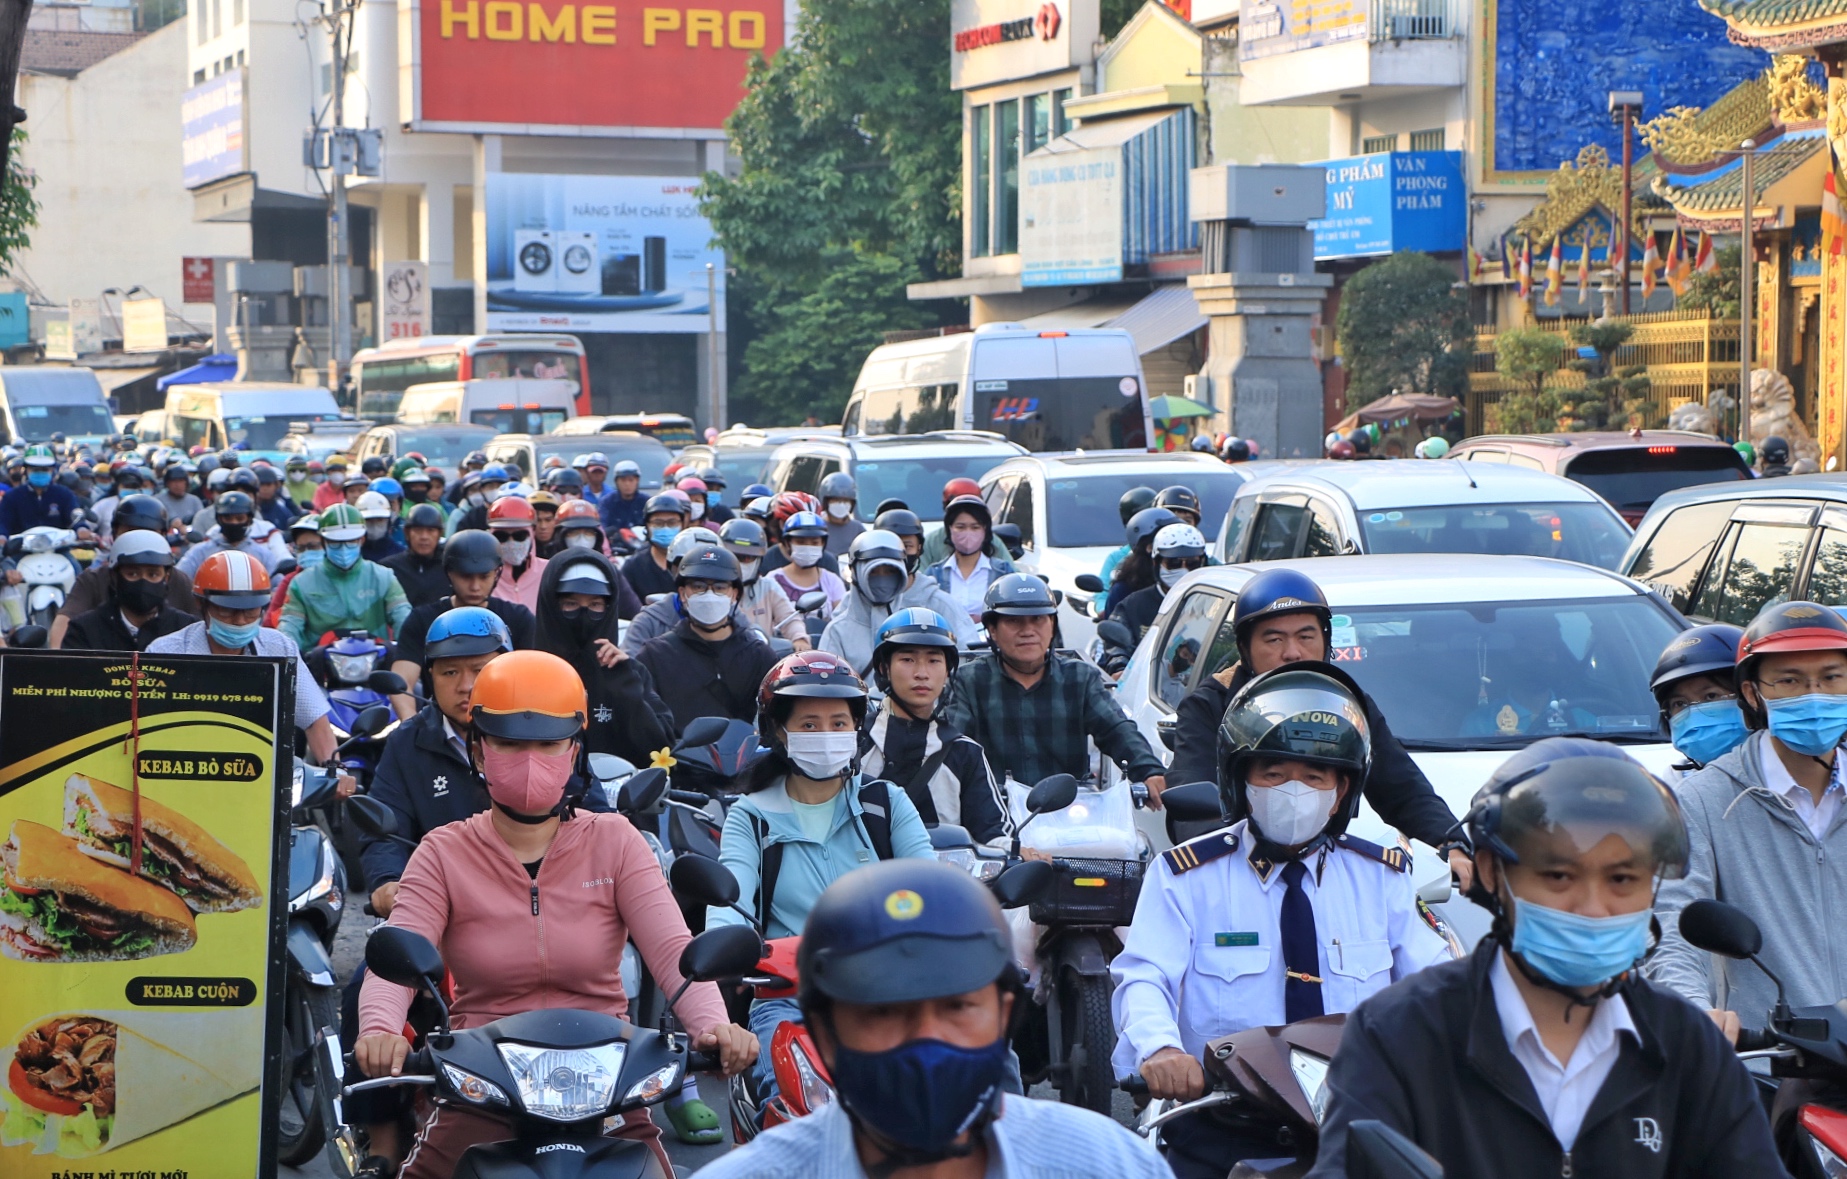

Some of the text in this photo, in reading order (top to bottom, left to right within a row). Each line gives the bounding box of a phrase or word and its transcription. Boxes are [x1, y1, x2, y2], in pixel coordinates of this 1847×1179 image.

[441, 0, 766, 49] HOME PRO
[1396, 173, 1448, 191] PHÒNG
[1396, 190, 1443, 209] PHẨM
[572, 204, 610, 217] NÂNG
[390, 321, 422, 338] 316
[1266, 599, 1303, 612] Andes
[141, 665, 176, 675] KEBAB
[111, 677, 168, 688] BÒ SỮA
[12, 685, 44, 696] MIỄN
[46, 687, 68, 697] PHÍ
[69, 688, 122, 700] NHƯỢNG
[172, 692, 192, 700] LH:
[194, 694, 219, 702] 0919
[222, 694, 242, 703] 678
[243, 695, 264, 704] 689
[1291, 710, 1339, 727] NOVA
[139, 758, 257, 776] KEBAB BÒ SỮA
[582, 877, 614, 888] ISOBLOX
[143, 982, 240, 1003] KEBAB CUỘN
[535, 1142, 587, 1155] HONDA
